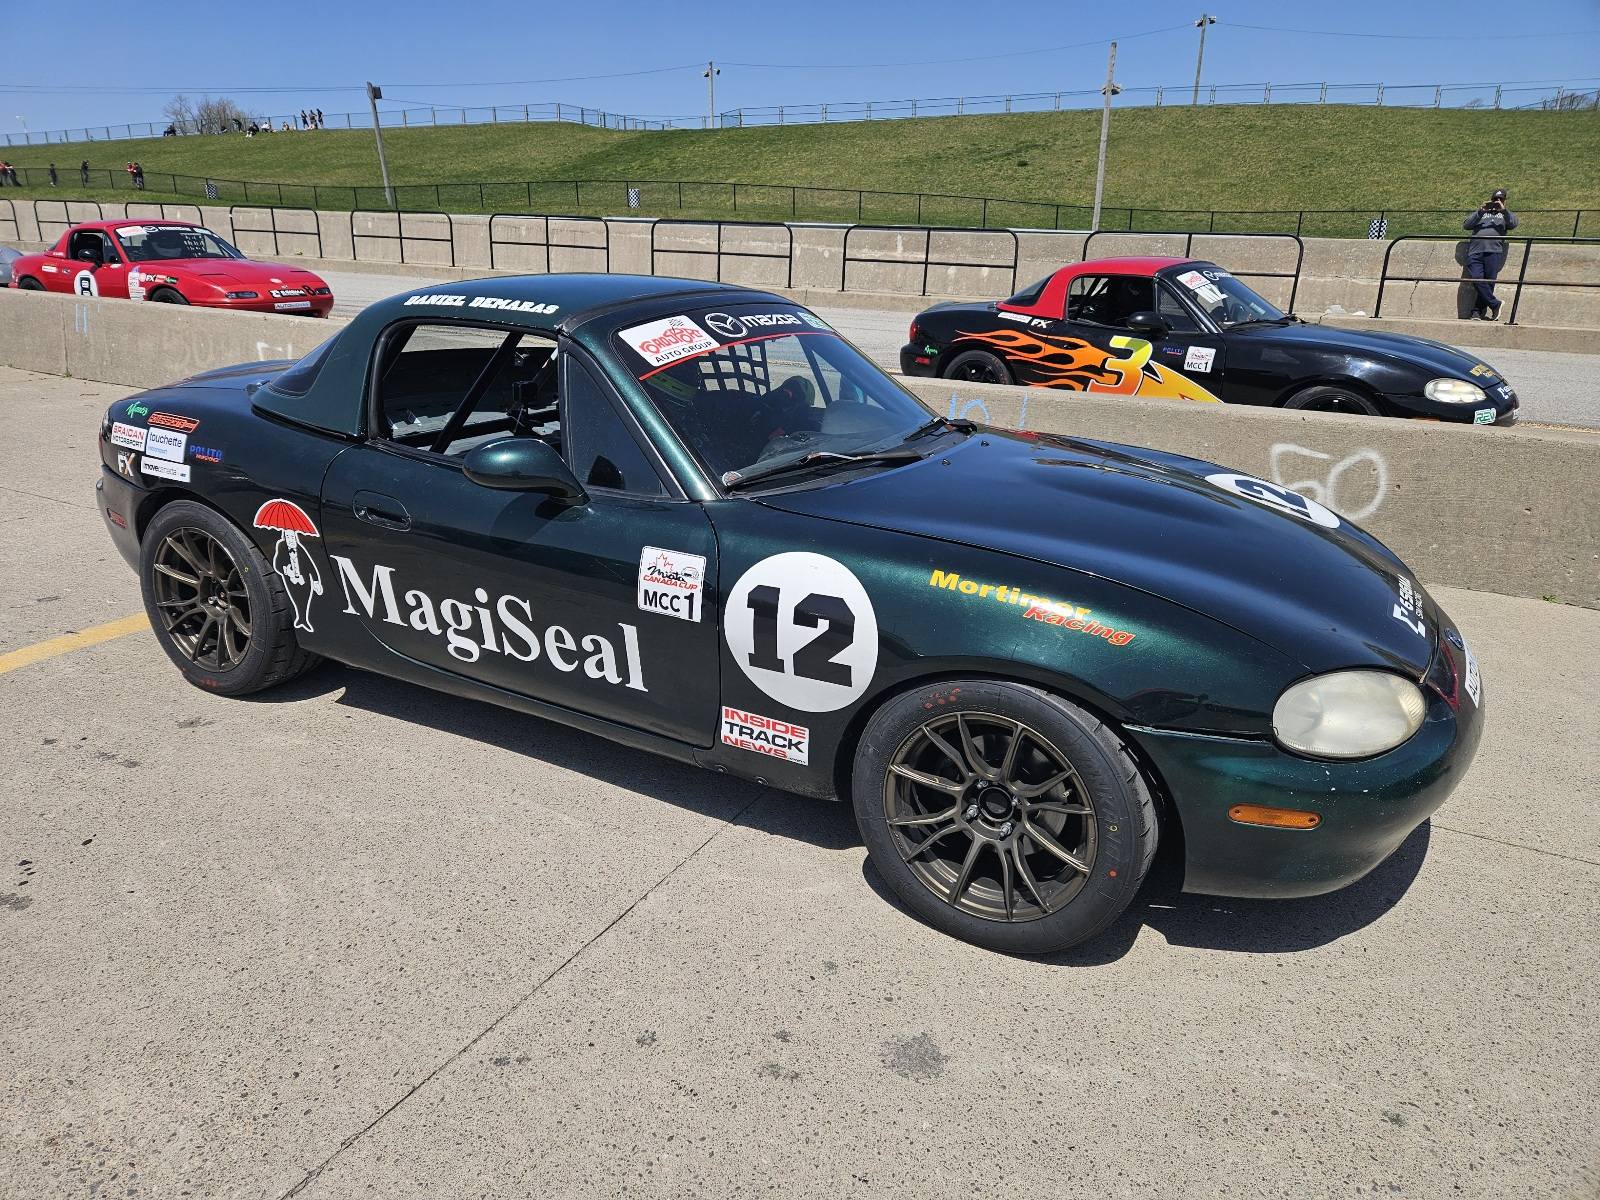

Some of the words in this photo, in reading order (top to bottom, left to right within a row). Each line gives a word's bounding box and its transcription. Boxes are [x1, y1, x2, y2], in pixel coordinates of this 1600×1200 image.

[404, 294, 467, 307] DANIEL
[468, 296, 560, 315] DEMARAS
[739, 313, 802, 328] mazda
[1031, 318, 1053, 329] FX
[655, 349, 682, 363] AUTO
[682, 341, 712, 354] GROUP
[1087, 335, 1153, 397] 3
[113, 424, 145, 441] BRAIDAN
[643, 574, 678, 589] CANADA
[679, 580, 698, 590] CUP
[647, 565, 686, 583] Miata
[330, 554, 649, 693] MagiSeal
[1023, 606, 1136, 646] Racing
[747, 584, 856, 688] 12
[724, 708, 807, 740] INSIDE
[723, 735, 788, 759] NEWS
[724, 720, 805, 754] TRACK
